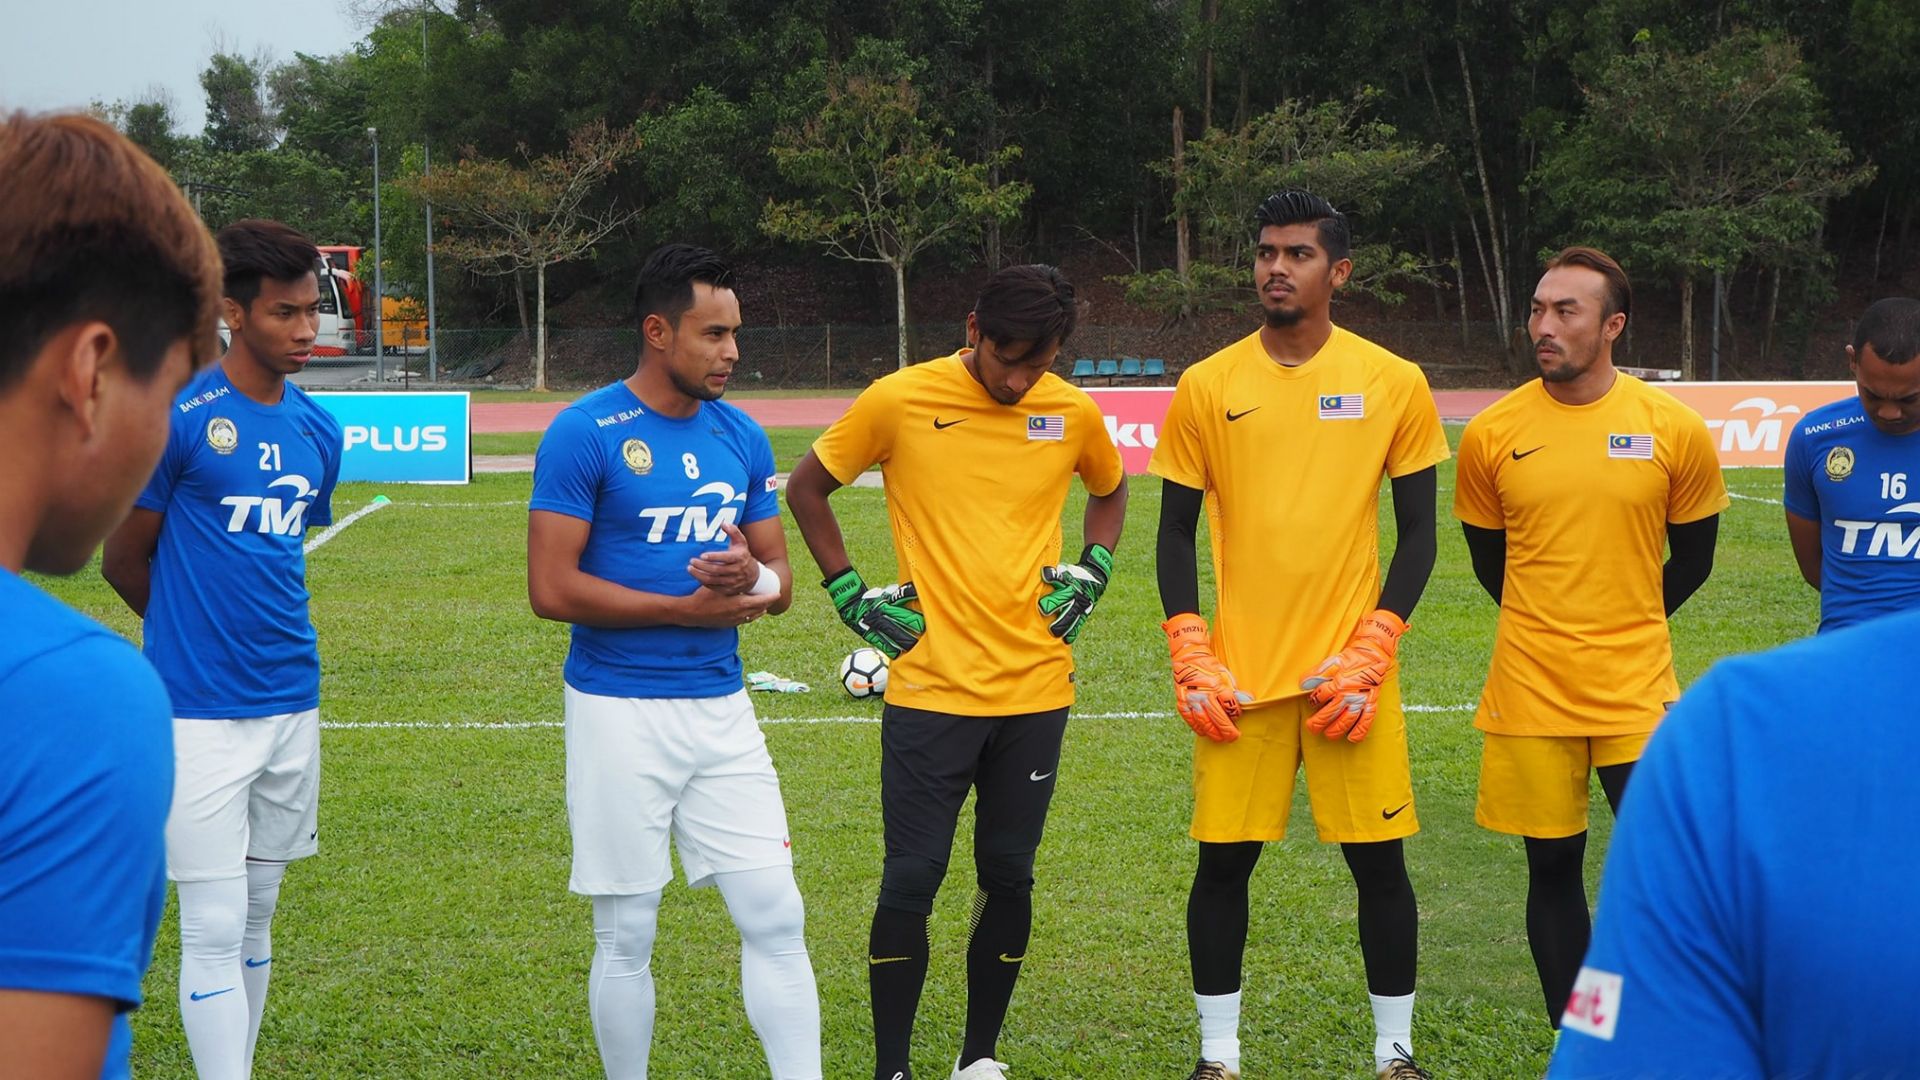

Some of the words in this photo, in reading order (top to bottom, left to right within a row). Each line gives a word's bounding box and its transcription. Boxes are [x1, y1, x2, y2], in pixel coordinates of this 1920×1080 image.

[179, 396, 203, 413] BANK
[202, 386, 231, 402] ISLAM
[595, 415, 618, 428] BANK
[618, 406, 645, 422] ISLAM
[1804, 421, 1832, 436] BANK
[1836, 415, 1865, 428] ISLAM
[343, 425, 447, 451] PLUS
[1707, 418, 1783, 451] M
[258, 442, 282, 472] 21
[681, 452, 700, 480] 8
[1880, 472, 1907, 500] 16
[220, 496, 310, 537] TM
[638, 506, 738, 544] TM
[1834, 519, 1920, 560] TM
